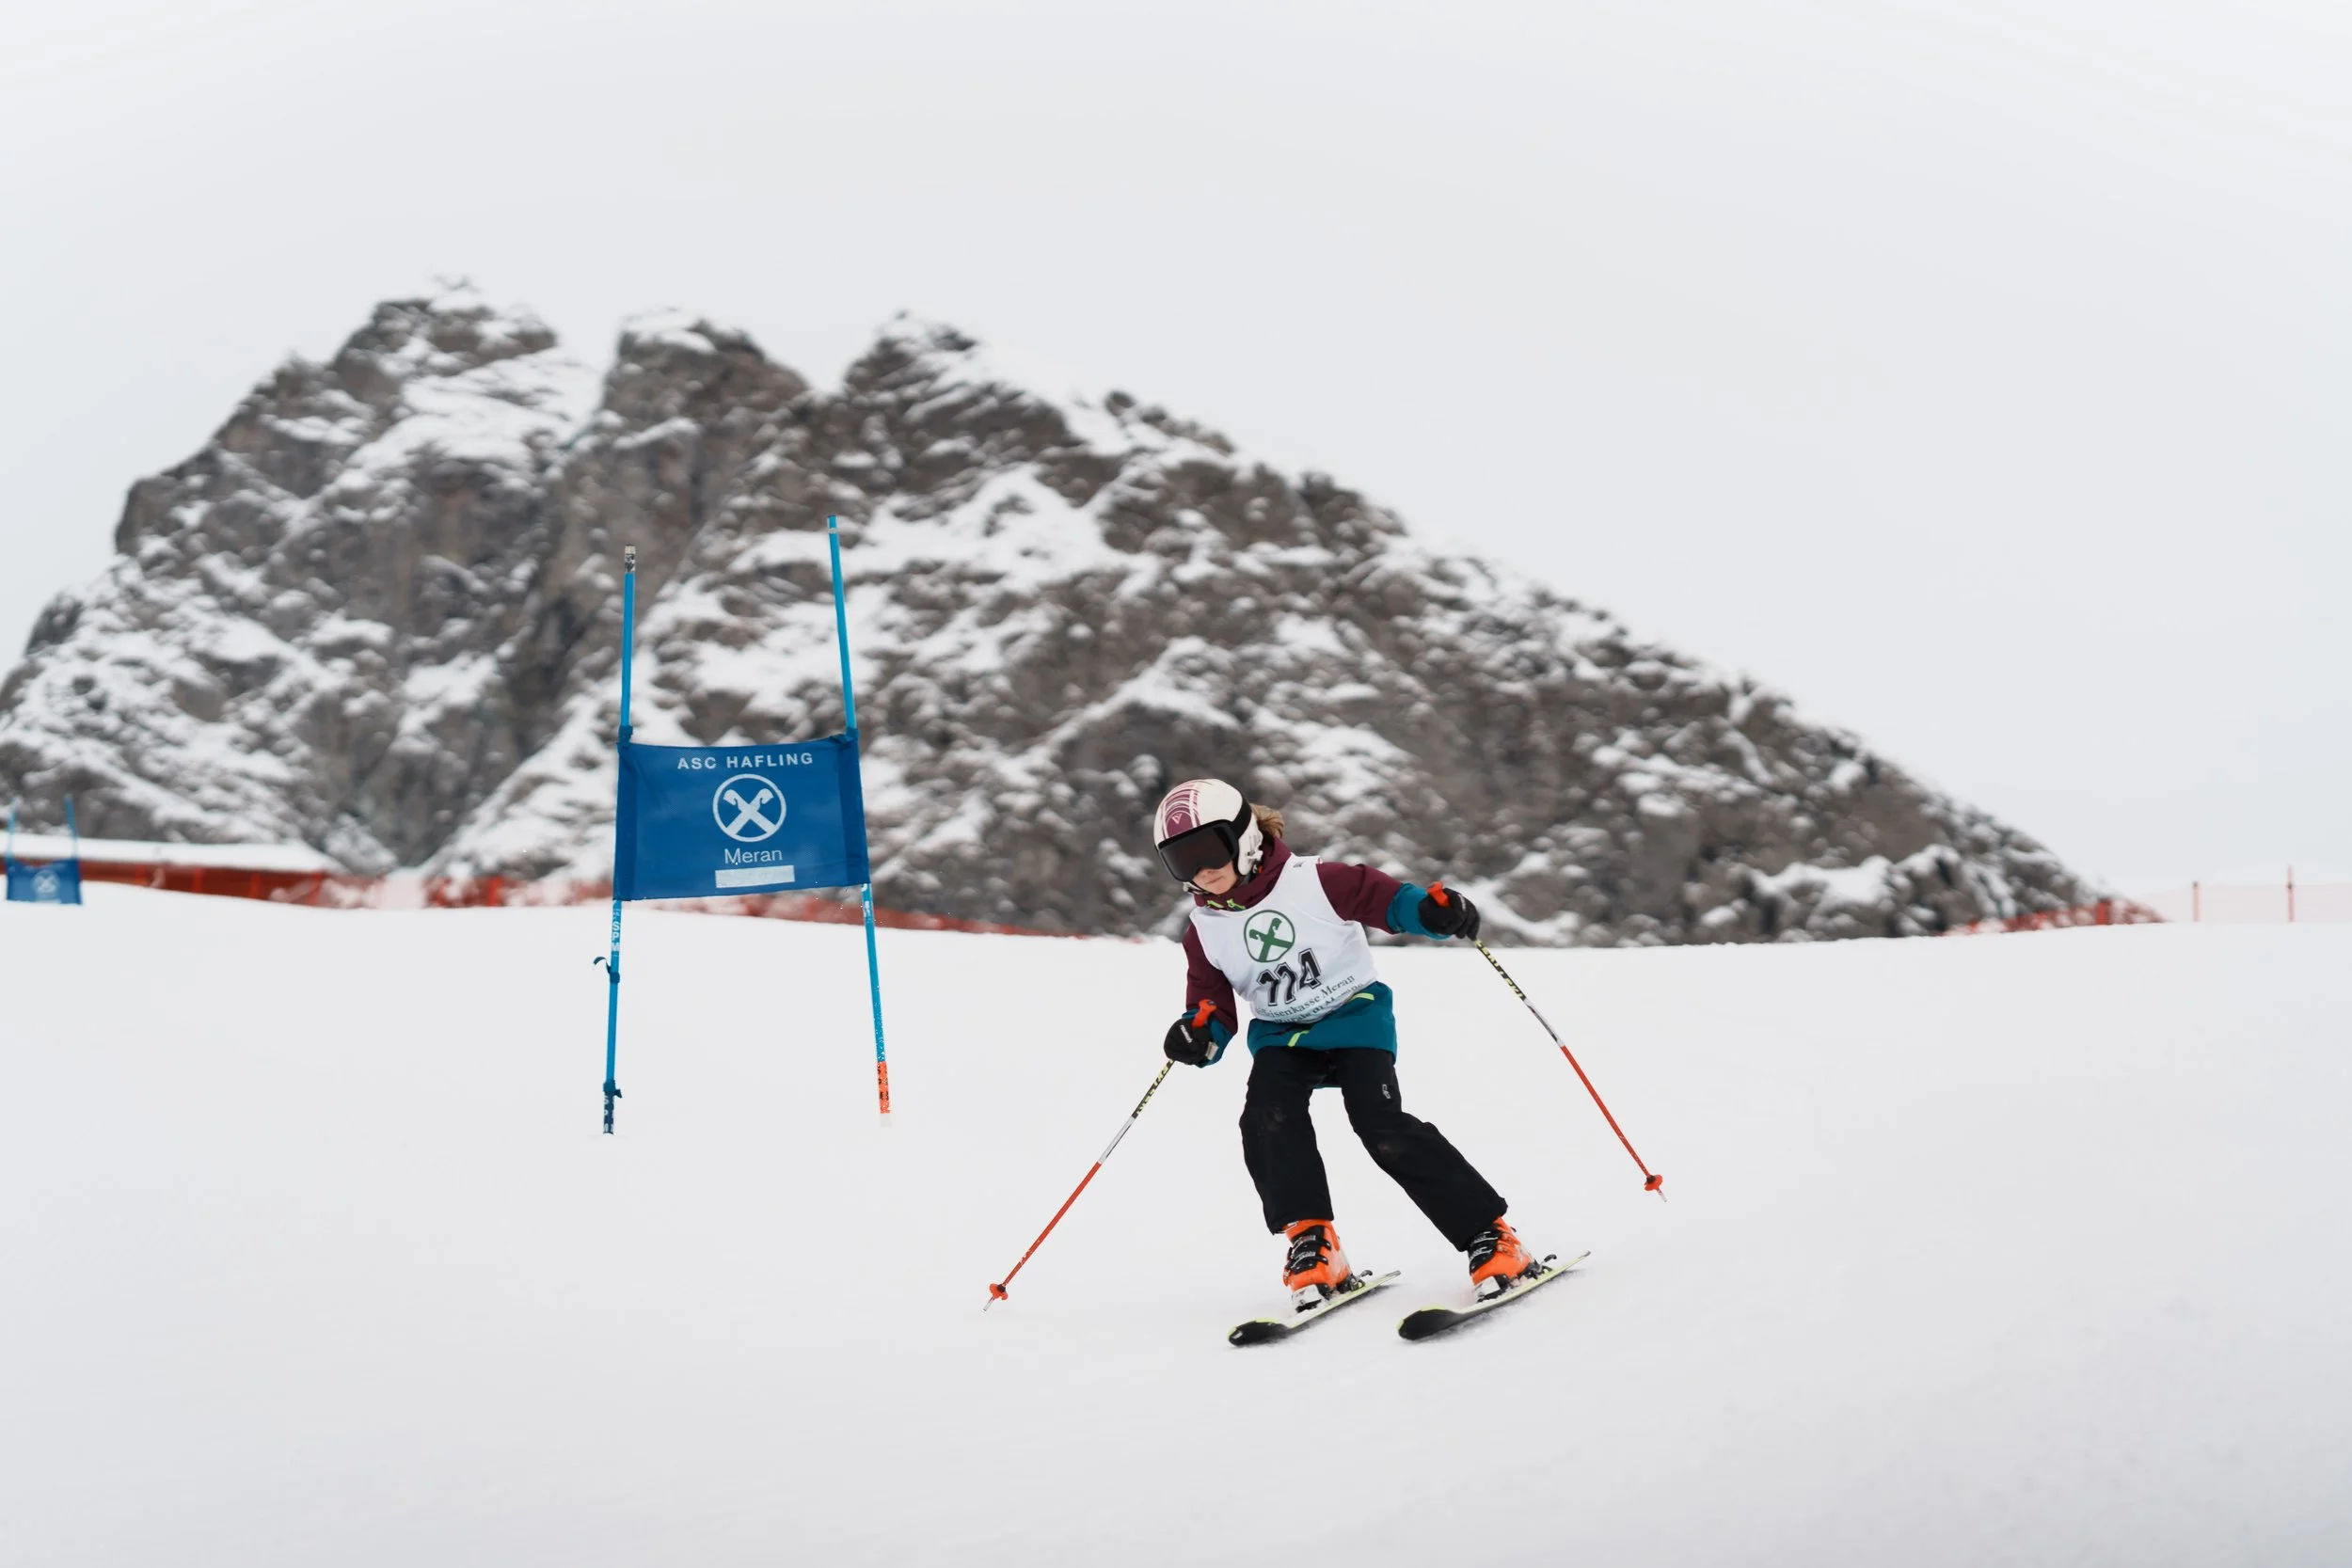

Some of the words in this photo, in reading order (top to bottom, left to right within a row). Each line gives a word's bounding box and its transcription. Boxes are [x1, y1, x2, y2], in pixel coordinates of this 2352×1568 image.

[677, 756, 717, 770] ASC
[726, 752, 814, 768] HAFLING
[724, 847, 783, 864] Meran
[1321, 975, 1356, 999] Meran
